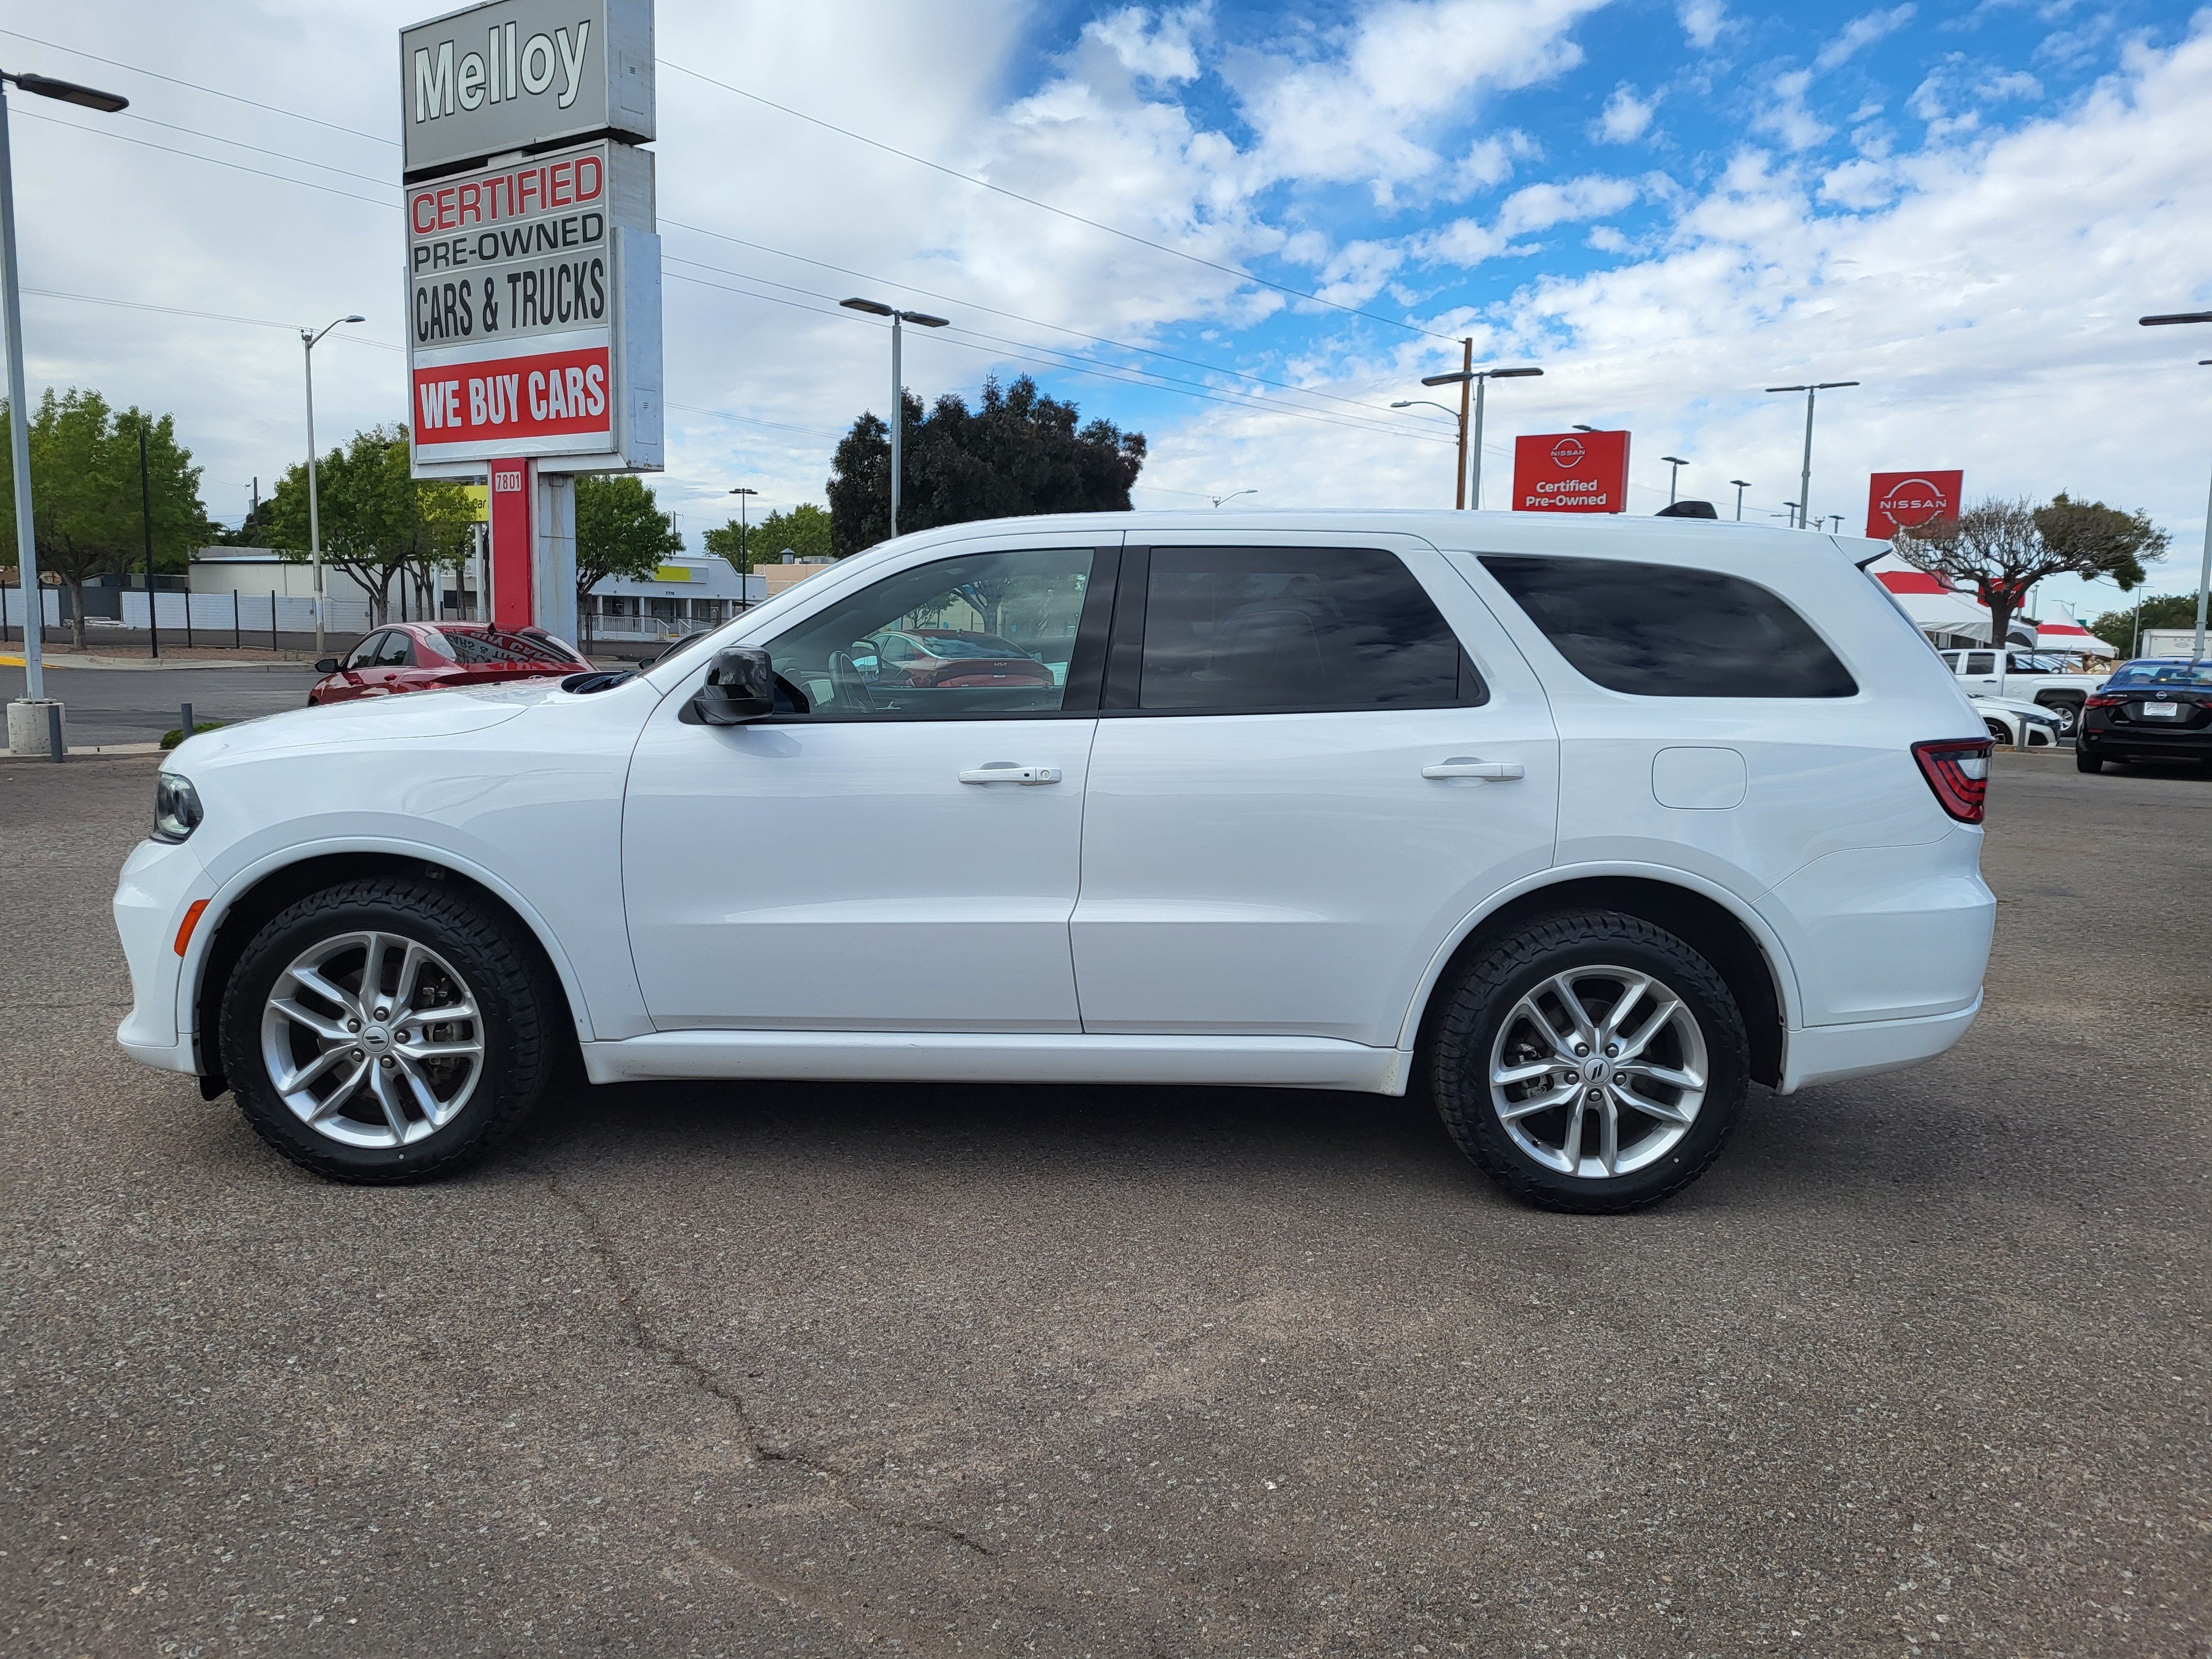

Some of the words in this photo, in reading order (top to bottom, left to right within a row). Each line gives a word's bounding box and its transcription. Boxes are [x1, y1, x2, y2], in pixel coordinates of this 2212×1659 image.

[414, 19, 591, 124] Melloy
[412, 155, 603, 234] CERTIFIED
[414, 213, 603, 273] PRE-OWNED
[416, 279, 473, 342] CARS
[483, 277, 499, 333] &
[507, 258, 604, 328] TRUCKS
[420, 380, 462, 429] WE
[469, 374, 519, 425] BUY
[528, 364, 605, 421] CARS
[497, 474, 520, 490] 7801
[1525, 493, 1606, 507] Pre-Owned
[1536, 479, 1598, 493] Certified
[1880, 499, 1947, 509] NISSAN
